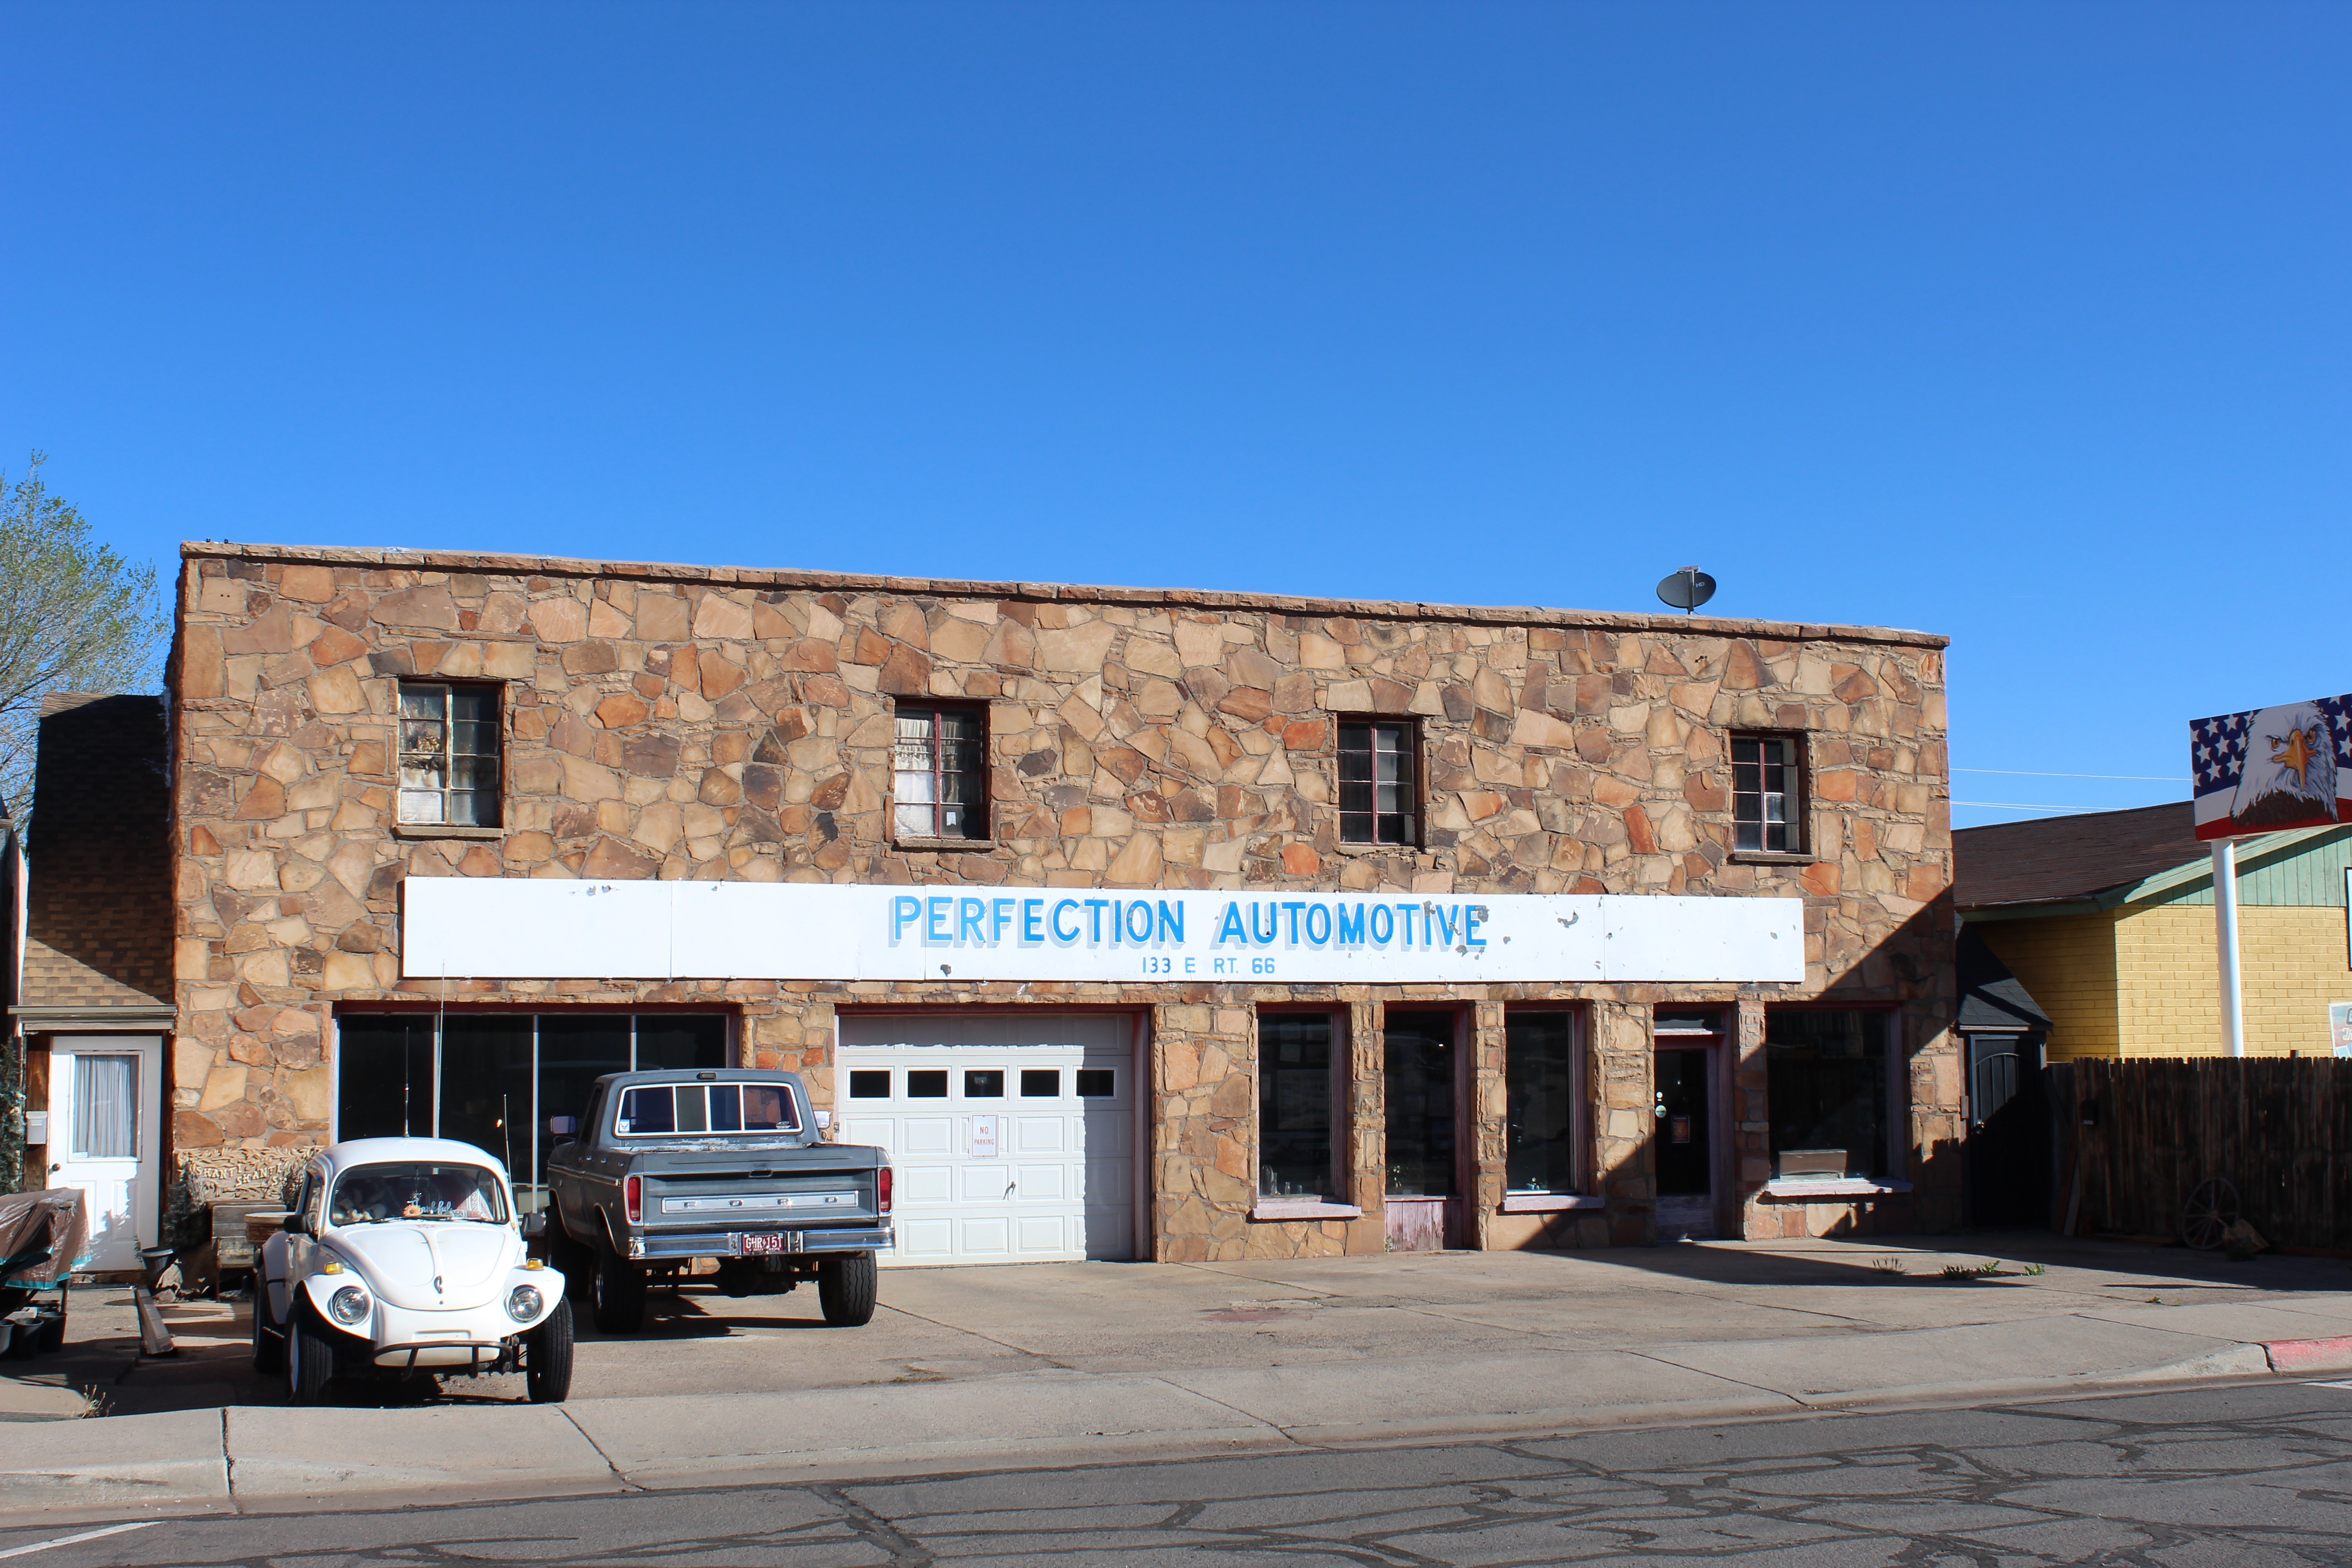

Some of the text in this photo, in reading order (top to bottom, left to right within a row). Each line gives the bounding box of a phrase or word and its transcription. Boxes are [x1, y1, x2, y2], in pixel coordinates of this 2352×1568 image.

[894, 895, 1487, 946] PERFECTION AUTOMOTIVE
[1142, 957, 1275, 974] 133 E RT. 66
[980, 1126, 989, 1134] NO
[196, 1164, 242, 1179] SHANTI
[235, 1163, 283, 1187] SHANTI
